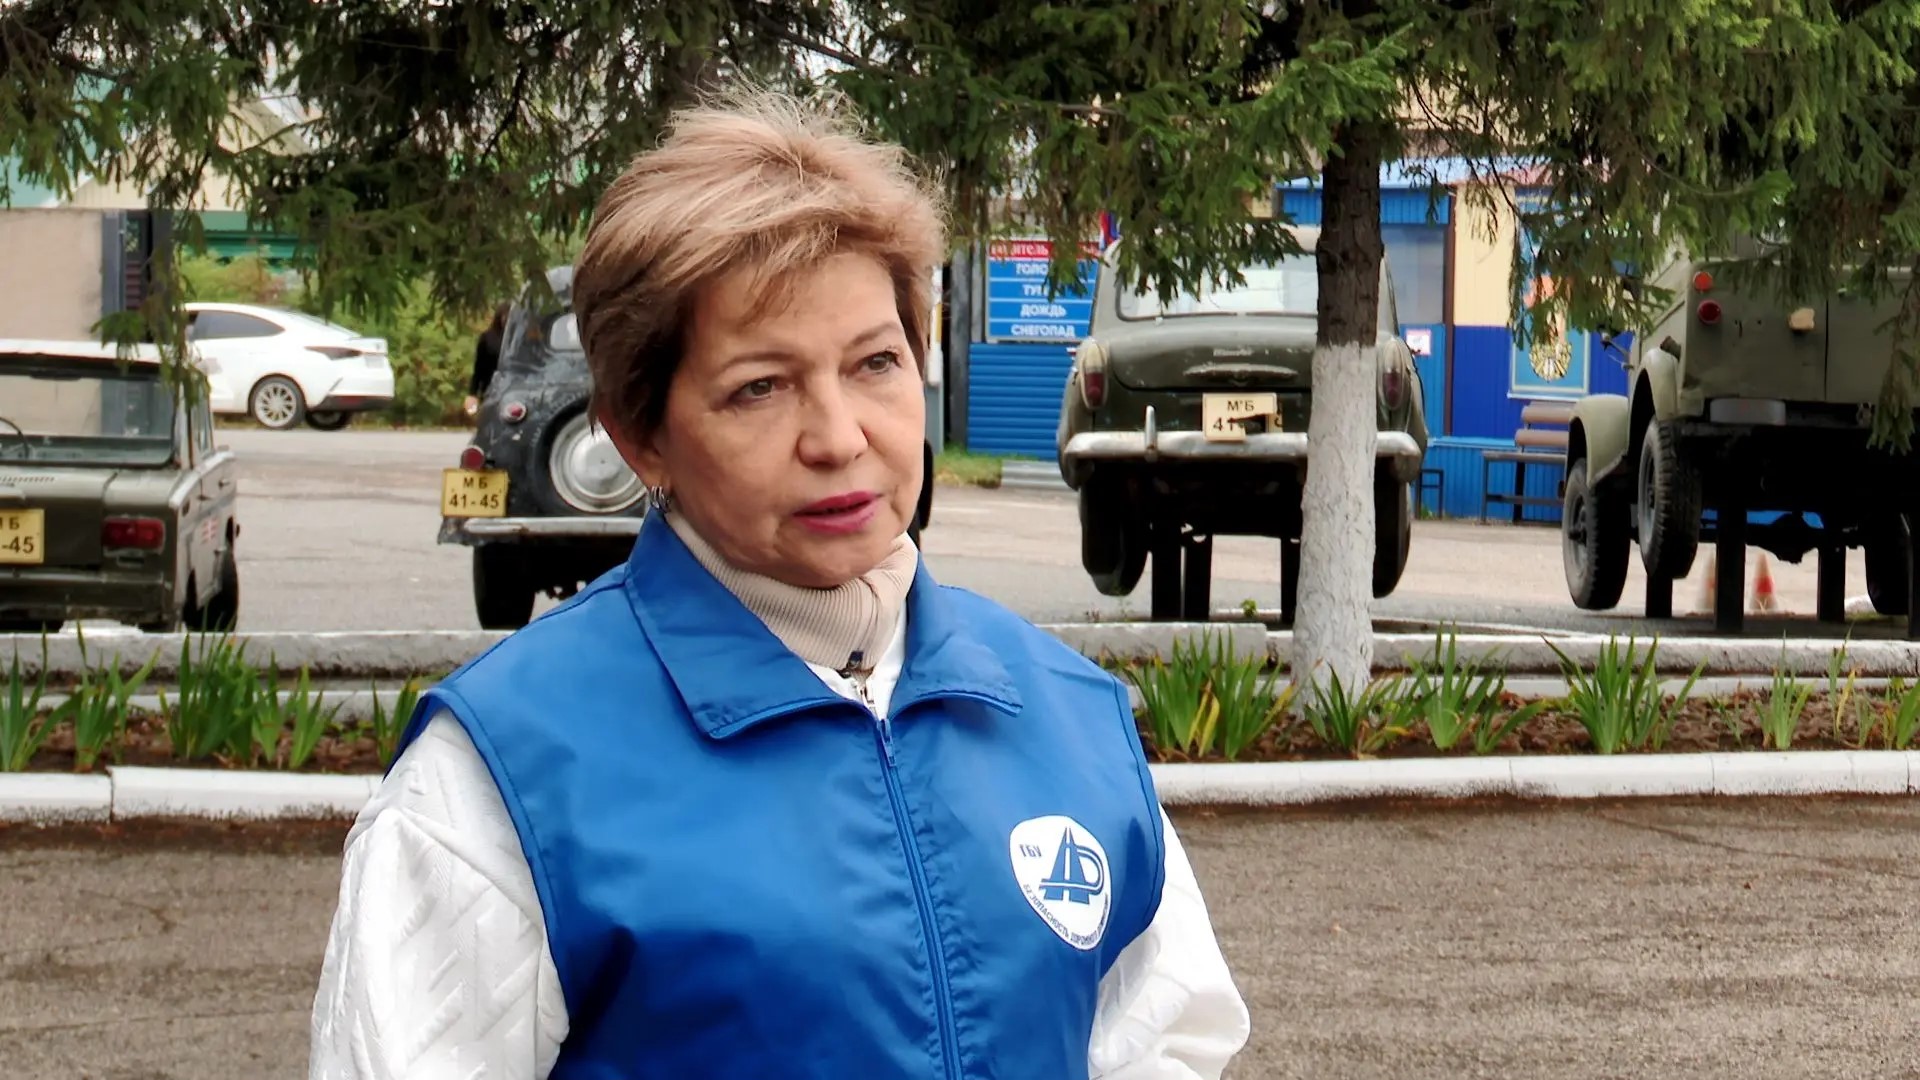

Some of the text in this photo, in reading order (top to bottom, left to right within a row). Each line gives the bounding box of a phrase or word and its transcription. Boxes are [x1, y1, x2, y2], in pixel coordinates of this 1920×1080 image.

[1021, 304, 1067, 317] ДОЖДЬ
[1011, 324, 1075, 337] СНЕГОПАД
[449, 494, 500, 509] 41-45
[1019, 844, 1042, 858] ГБУ
